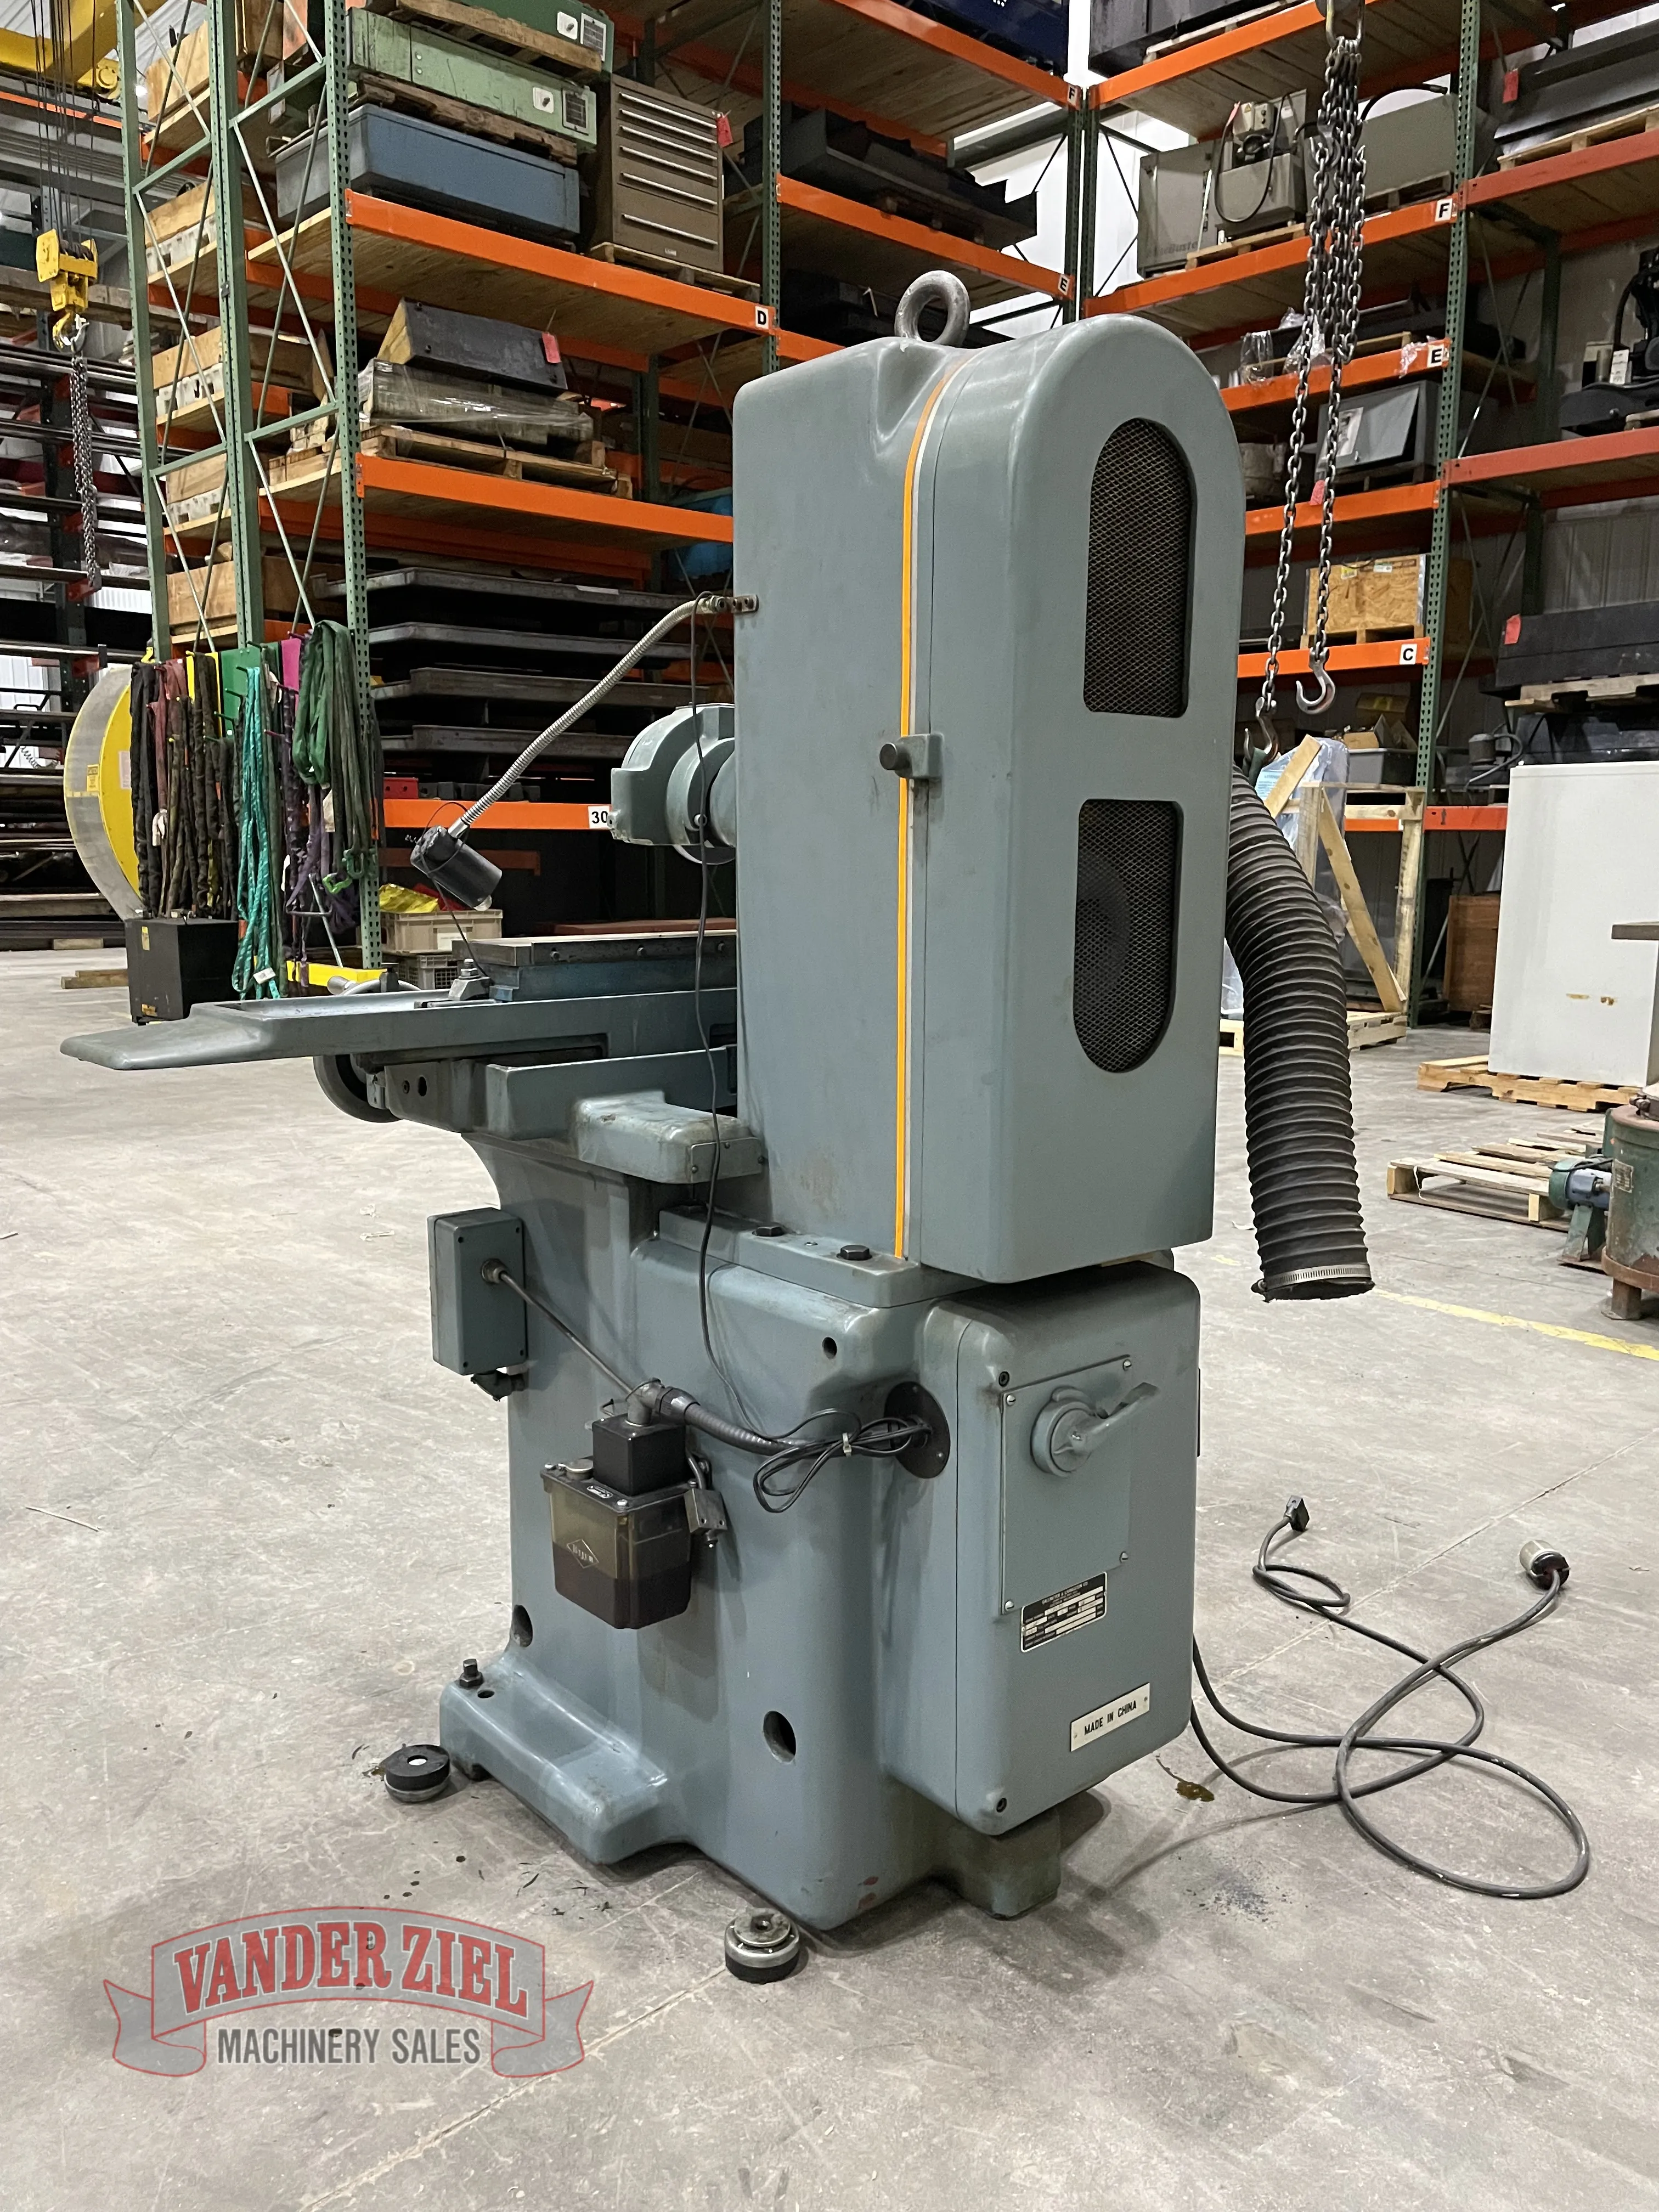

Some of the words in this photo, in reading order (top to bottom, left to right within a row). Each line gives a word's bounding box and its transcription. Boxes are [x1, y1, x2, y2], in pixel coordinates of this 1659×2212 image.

[1069, 87, 1075, 99] F
[1439, 203, 1449, 218] F
[1060, 277, 1068, 292] E
[757, 310, 766, 325] D
[1431, 348, 1442, 363] E
[1403, 648, 1414, 661] C
[591, 811, 608, 823] 30
[1084, 1717, 1103, 1735] MADE
[1107, 1711, 1114, 1723] IN
[1118, 1700, 1137, 1717] CHINA
